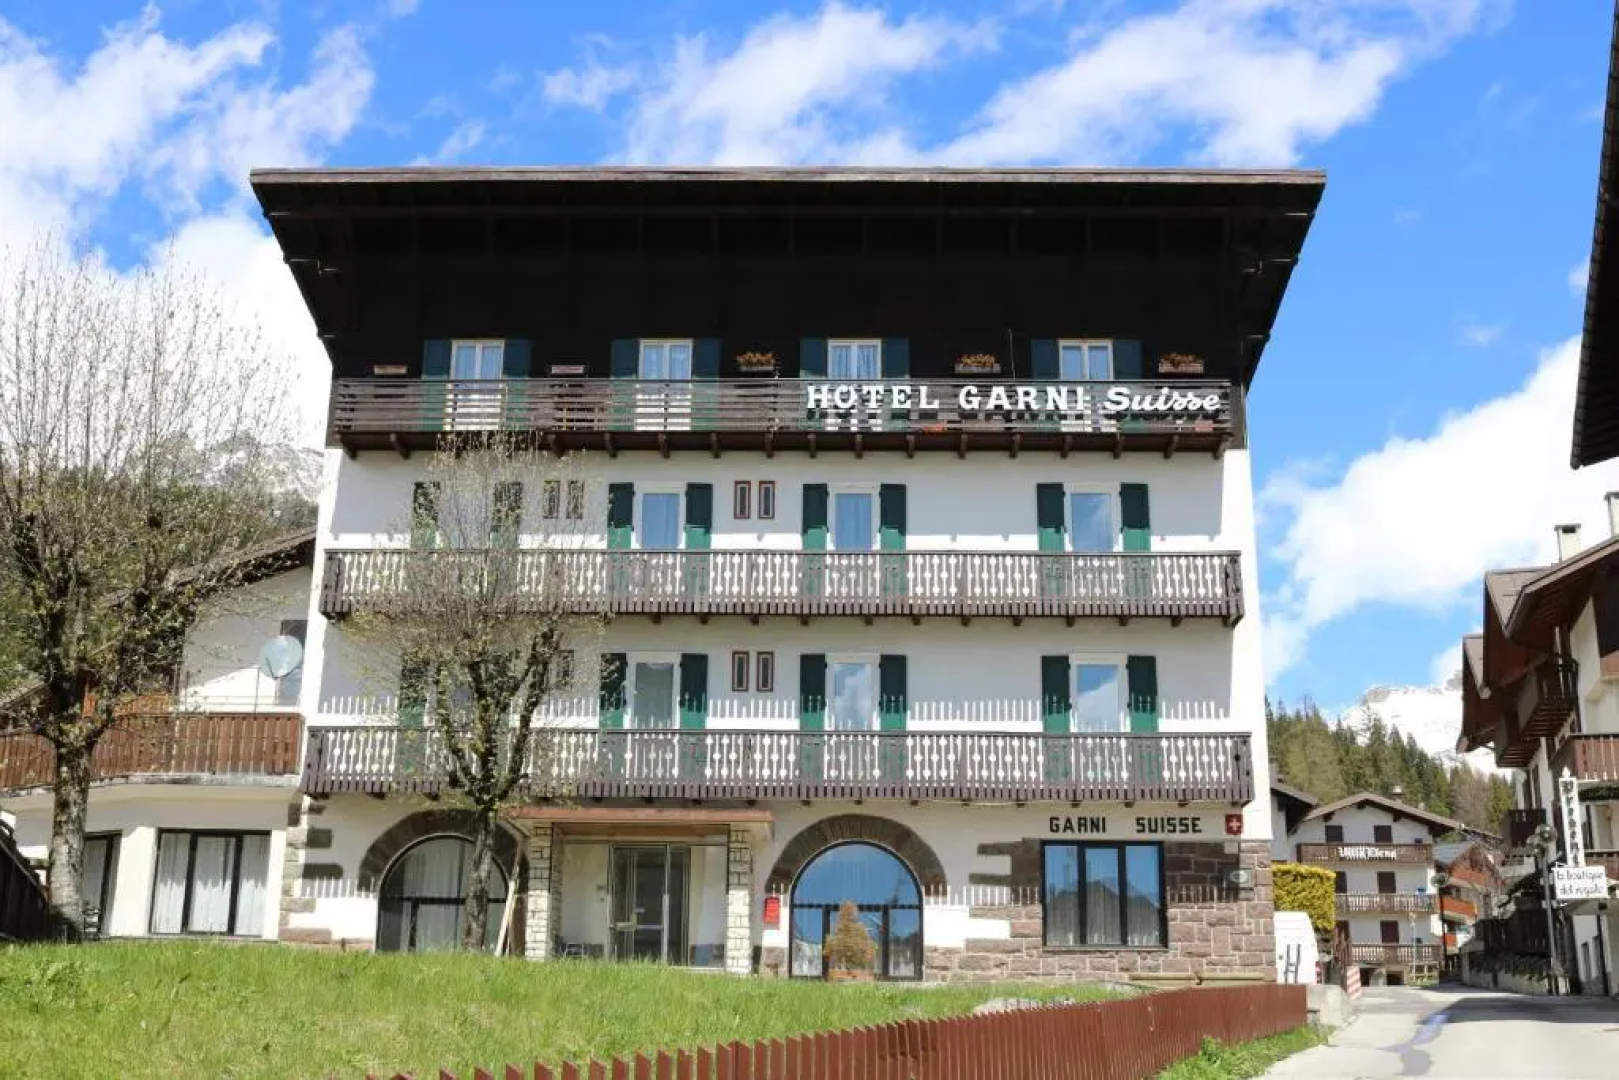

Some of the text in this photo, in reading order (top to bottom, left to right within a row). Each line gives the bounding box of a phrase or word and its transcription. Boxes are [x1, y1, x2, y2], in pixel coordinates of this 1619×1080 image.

[807, 385, 1221, 412] HOTEL GARNI Suisse
[1049, 817, 1202, 833] GARNI SUISSE
[1567, 870, 1603, 882] boutique
